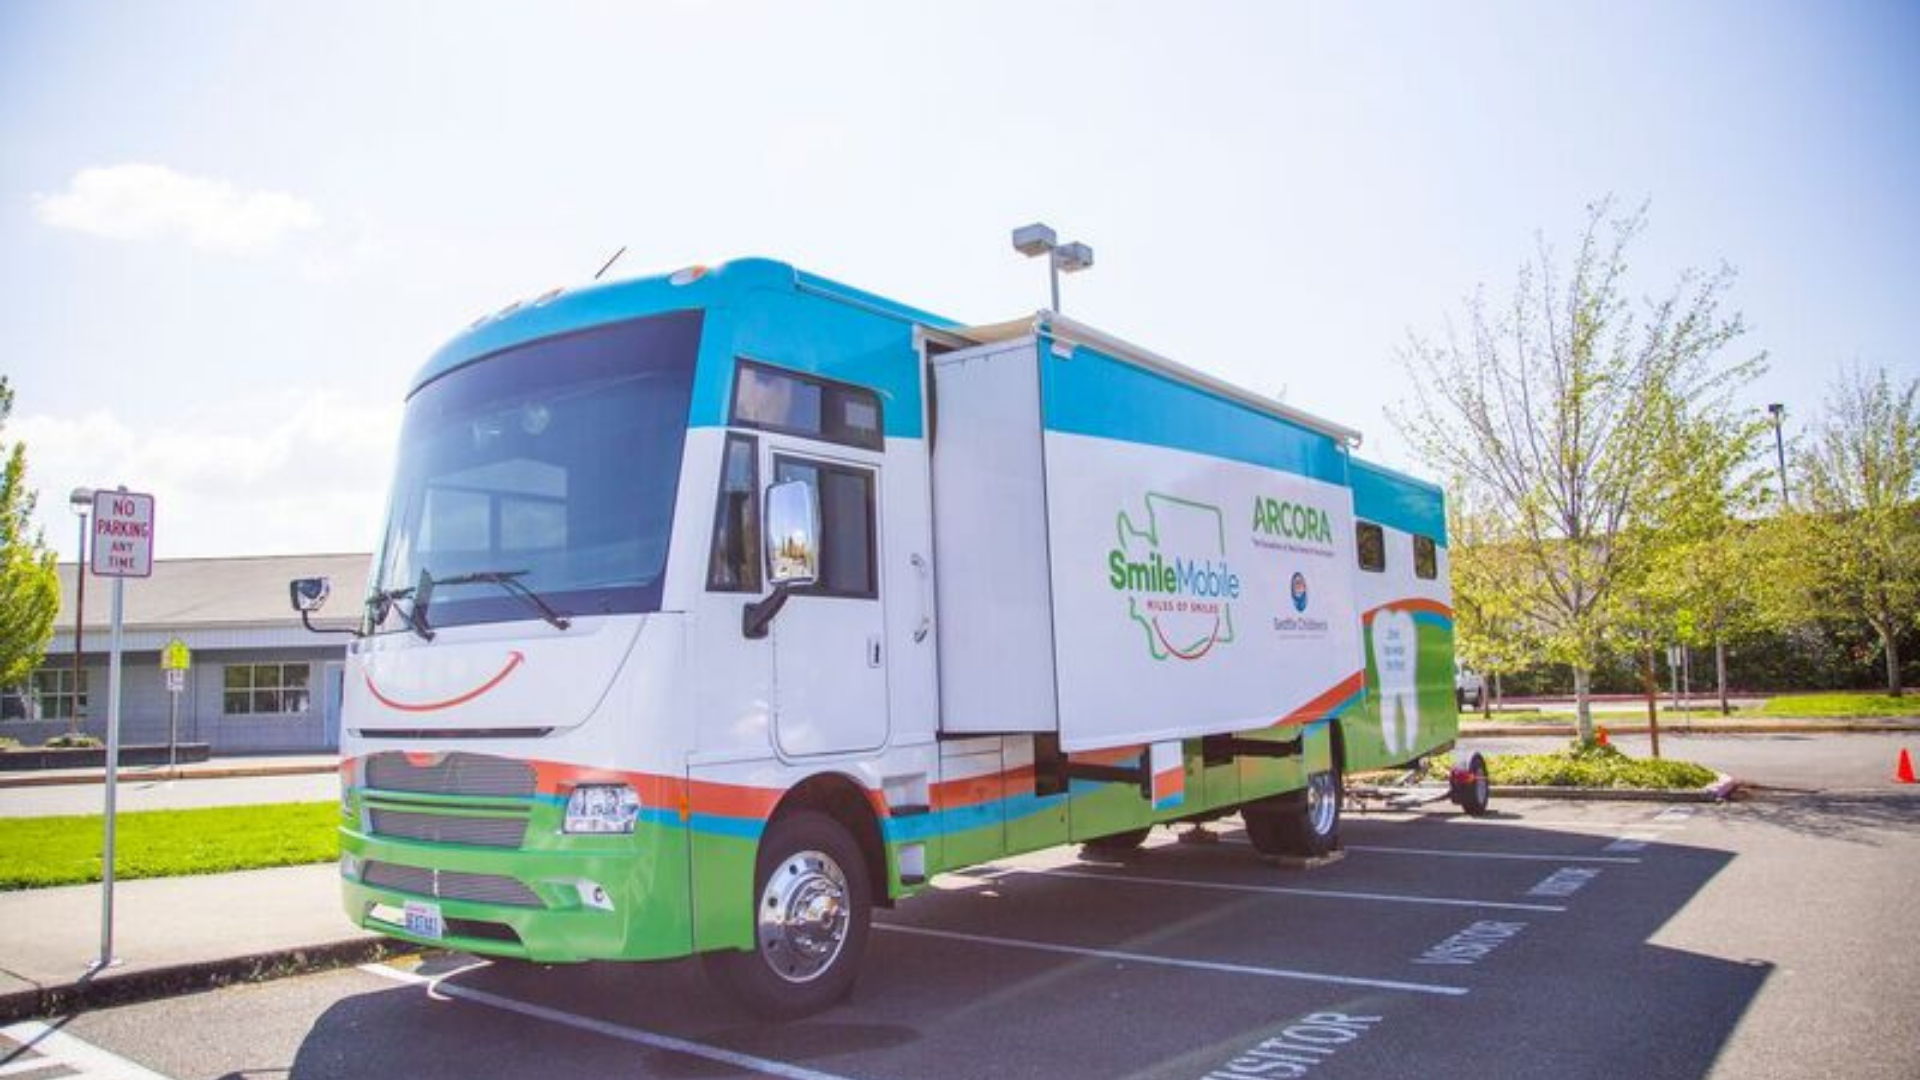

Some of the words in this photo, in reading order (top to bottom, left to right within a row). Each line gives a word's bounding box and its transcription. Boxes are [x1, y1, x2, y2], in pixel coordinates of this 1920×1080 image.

[113, 501, 135, 516] NO
[1253, 496, 1332, 543] ARCORA
[98, 519, 149, 537] PARKING
[109, 556, 135, 568] TIME
[111, 541, 134, 553] ANY
[1109, 550, 1240, 599] SmileMobile
[1409, 920, 1529, 964] VISITOR
[1199, 1012, 1382, 1080] ISITOR
